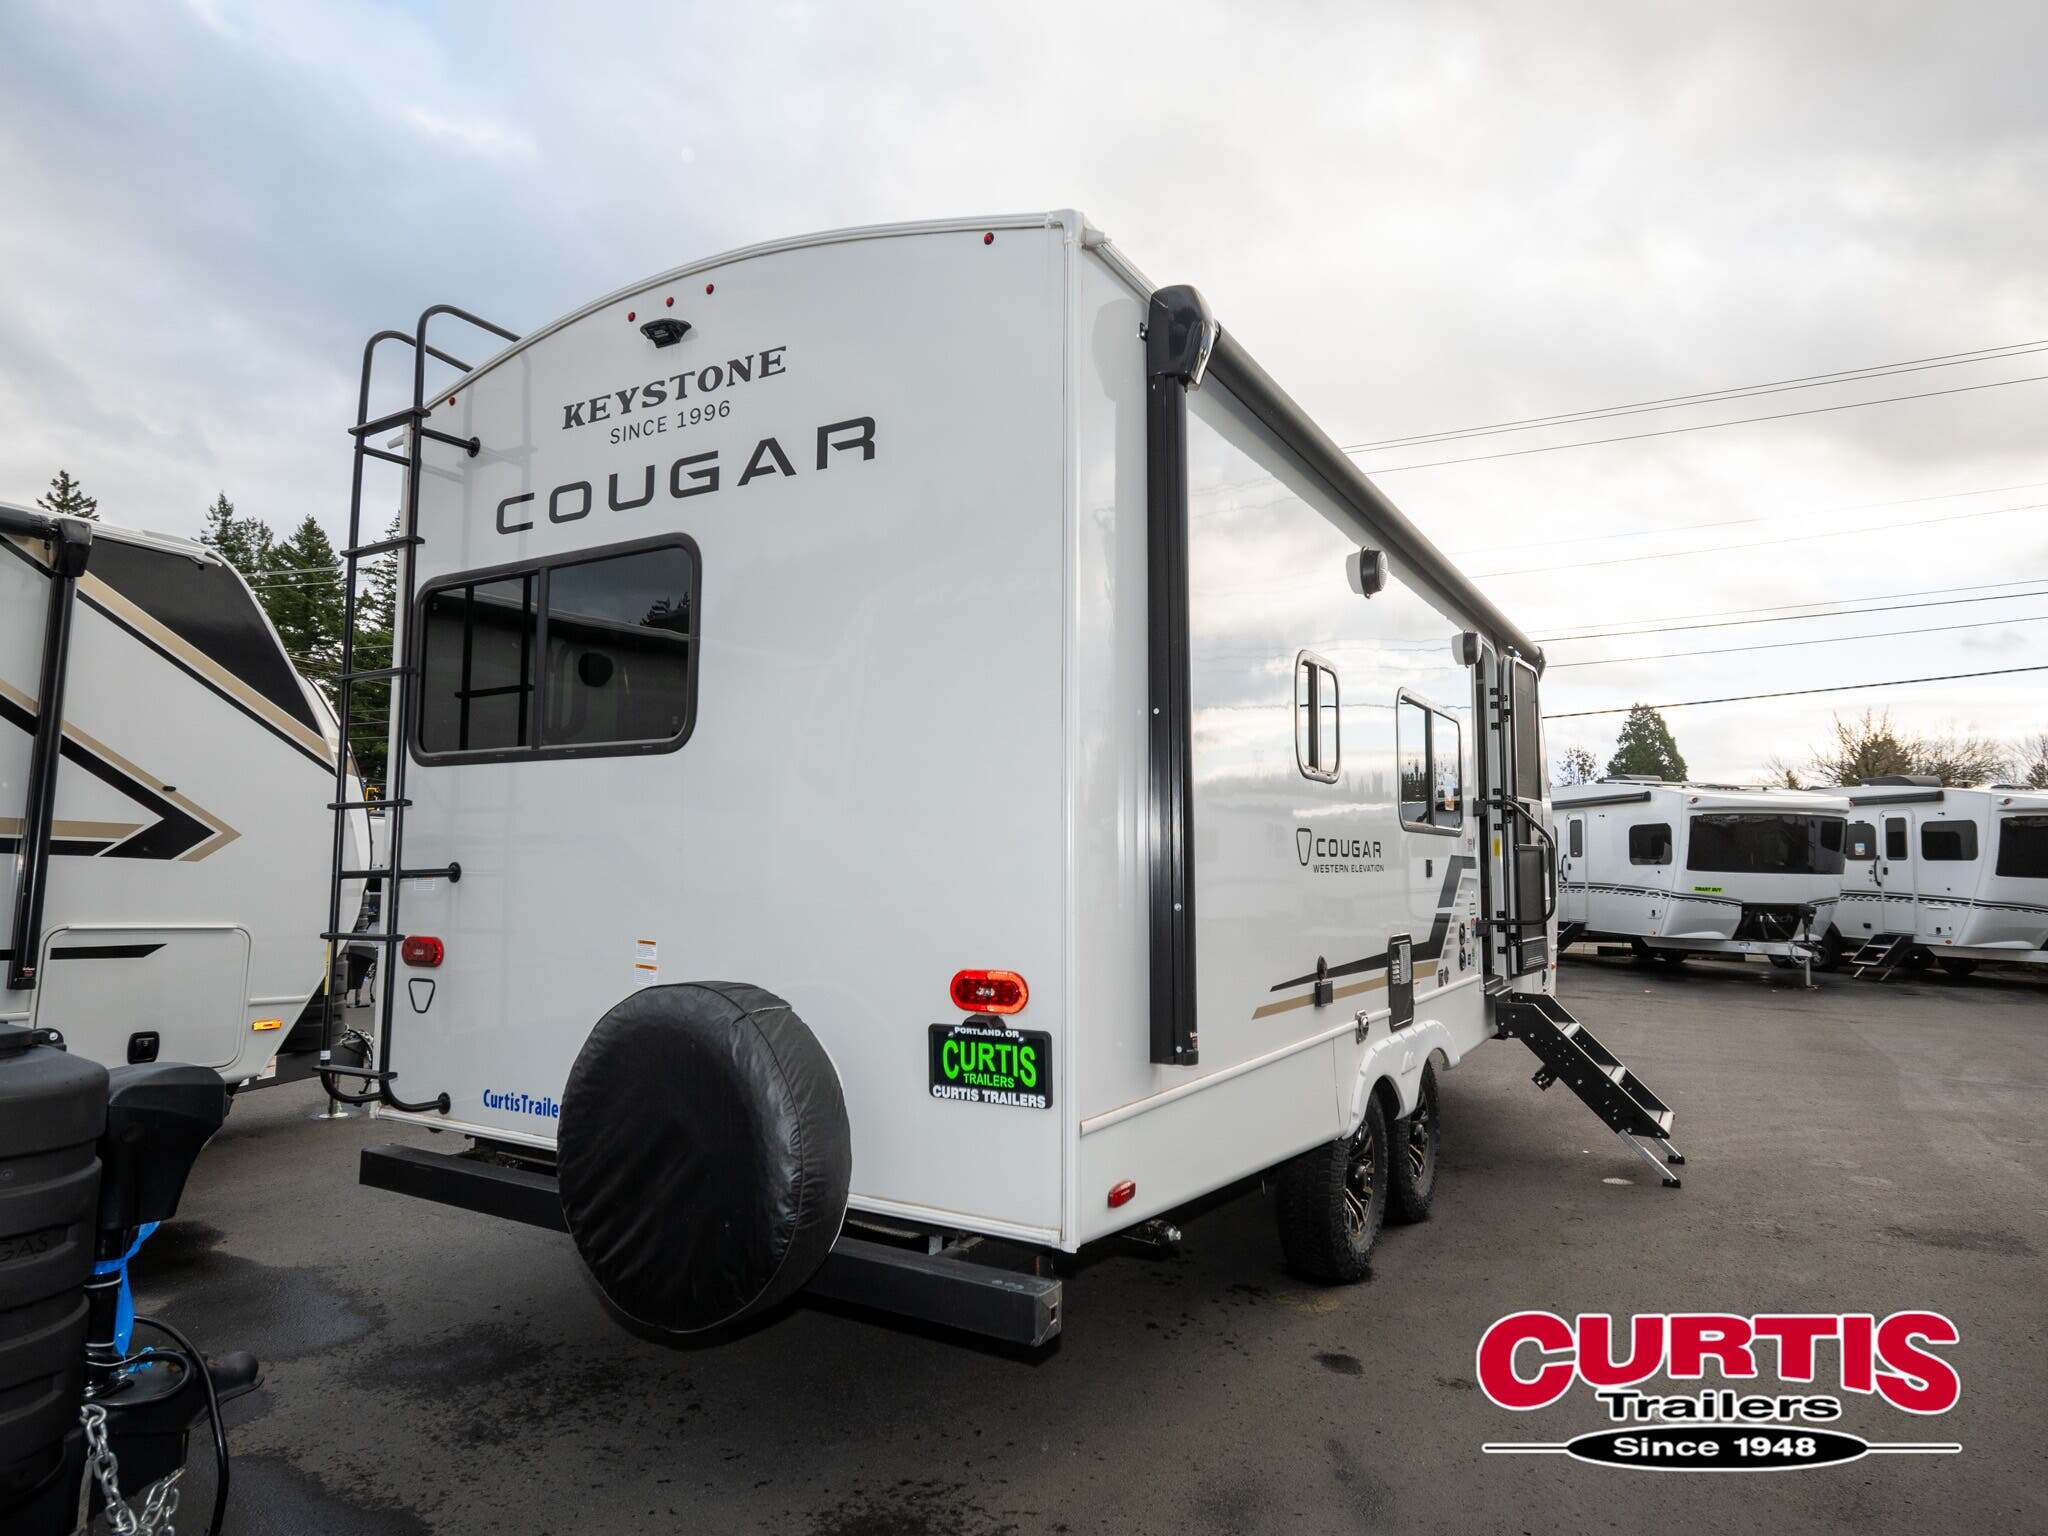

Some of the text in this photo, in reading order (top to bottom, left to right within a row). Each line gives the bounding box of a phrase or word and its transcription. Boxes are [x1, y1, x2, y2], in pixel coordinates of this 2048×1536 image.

[562, 346, 787, 430] KEYSTONE
[610, 400, 731, 444] SINCE 1996
[496, 416, 876, 535] COUGAR
[1316, 838, 1382, 858] COUGAR
[1313, 864, 1385, 873] WESTERN ELEVATION
[954, 1026, 1019, 1039] PORTLAND, OR
[943, 1040, 1036, 1087] CURTIS
[963, 1073, 1015, 1088] TRAILERS
[483, 1089, 560, 1118] CurtisTraile
[932, 1085, 1046, 1108] CURTIS TRAILERS
